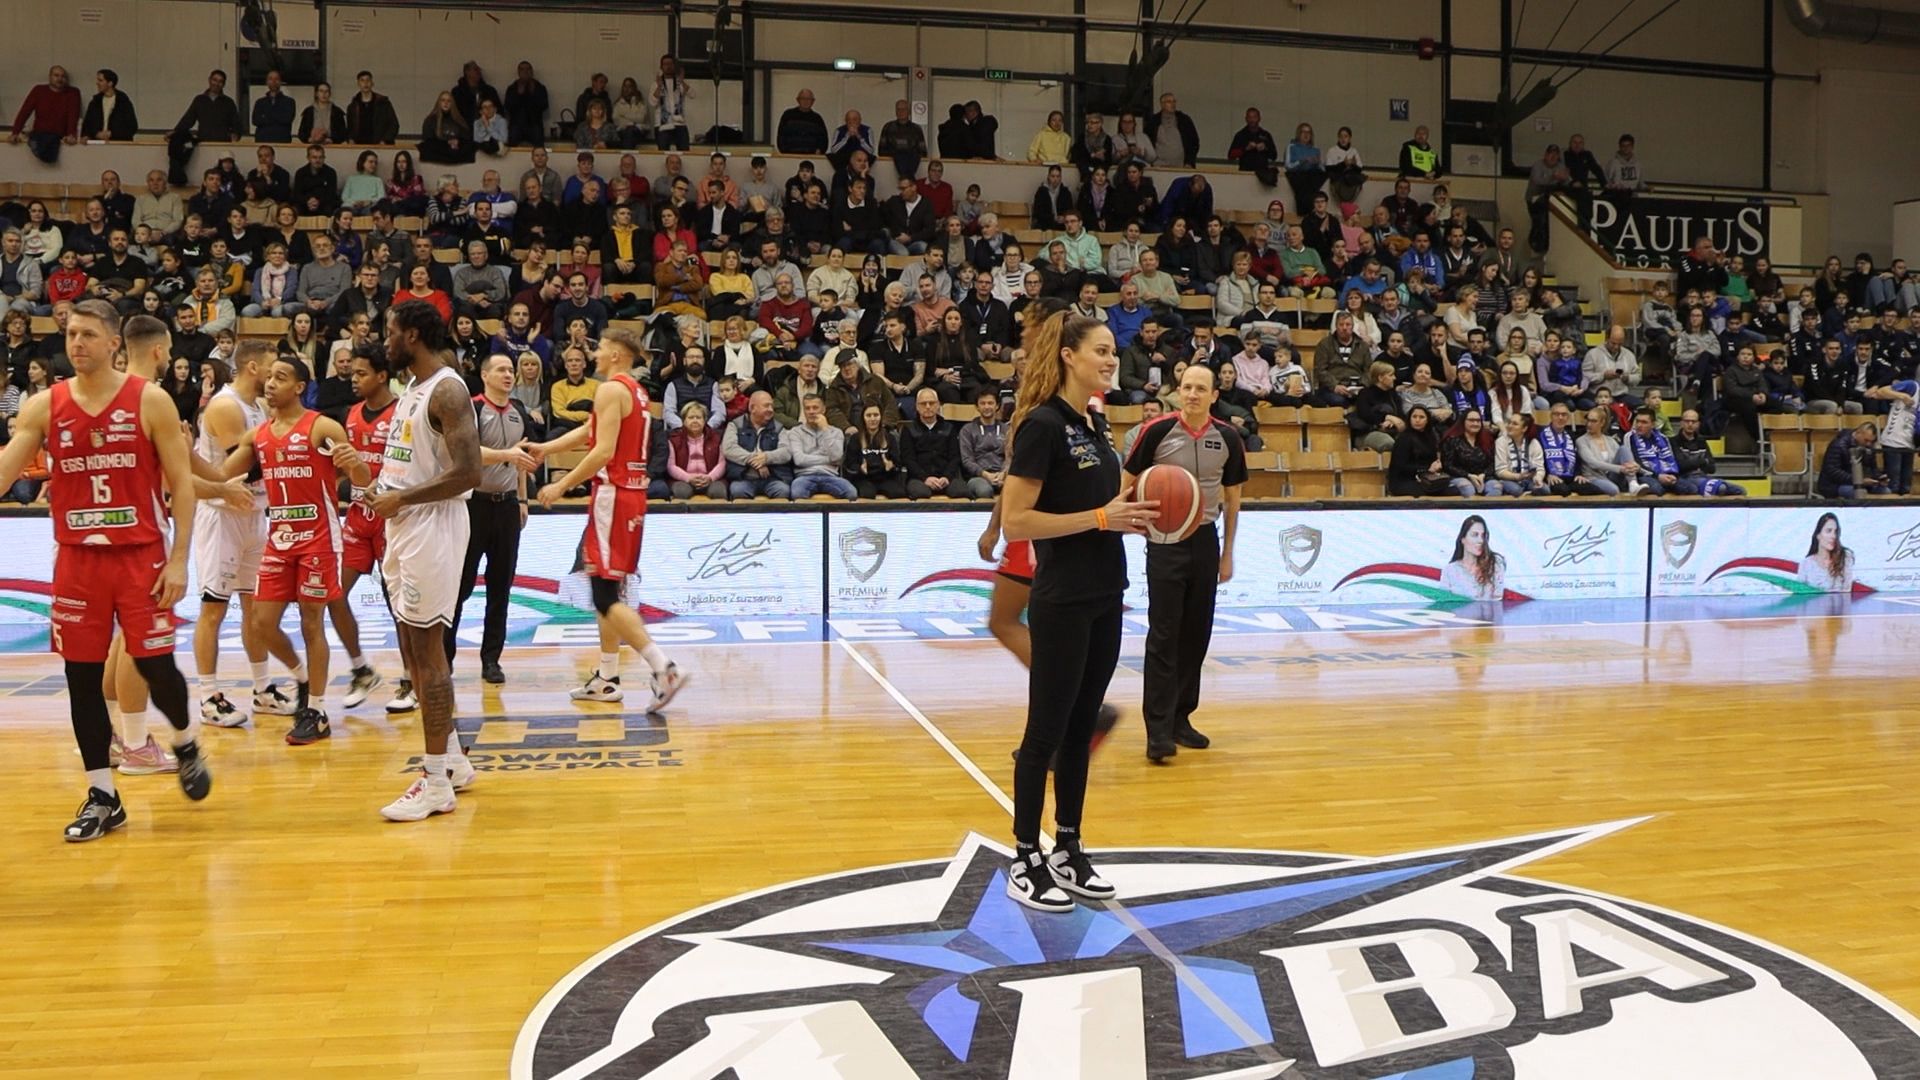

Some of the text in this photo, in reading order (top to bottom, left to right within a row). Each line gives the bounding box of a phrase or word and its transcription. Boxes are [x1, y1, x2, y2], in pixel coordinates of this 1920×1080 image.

[988, 71, 1008, 79] EXIT
[1392, 100, 1407, 112] WC
[60, 453, 136, 473] EGIS KÖRMEND
[90, 474, 112, 504] 15
[279, 481, 288, 504] 1
[282, 530, 315, 541] EGIS
[1658, 572, 1697, 581] PRÉMIUM
[1277, 581, 1322, 590] PRÉMIUM
[838, 586, 888, 597] PRÉMIUM
[400, 759, 684, 773] AROSPACE
